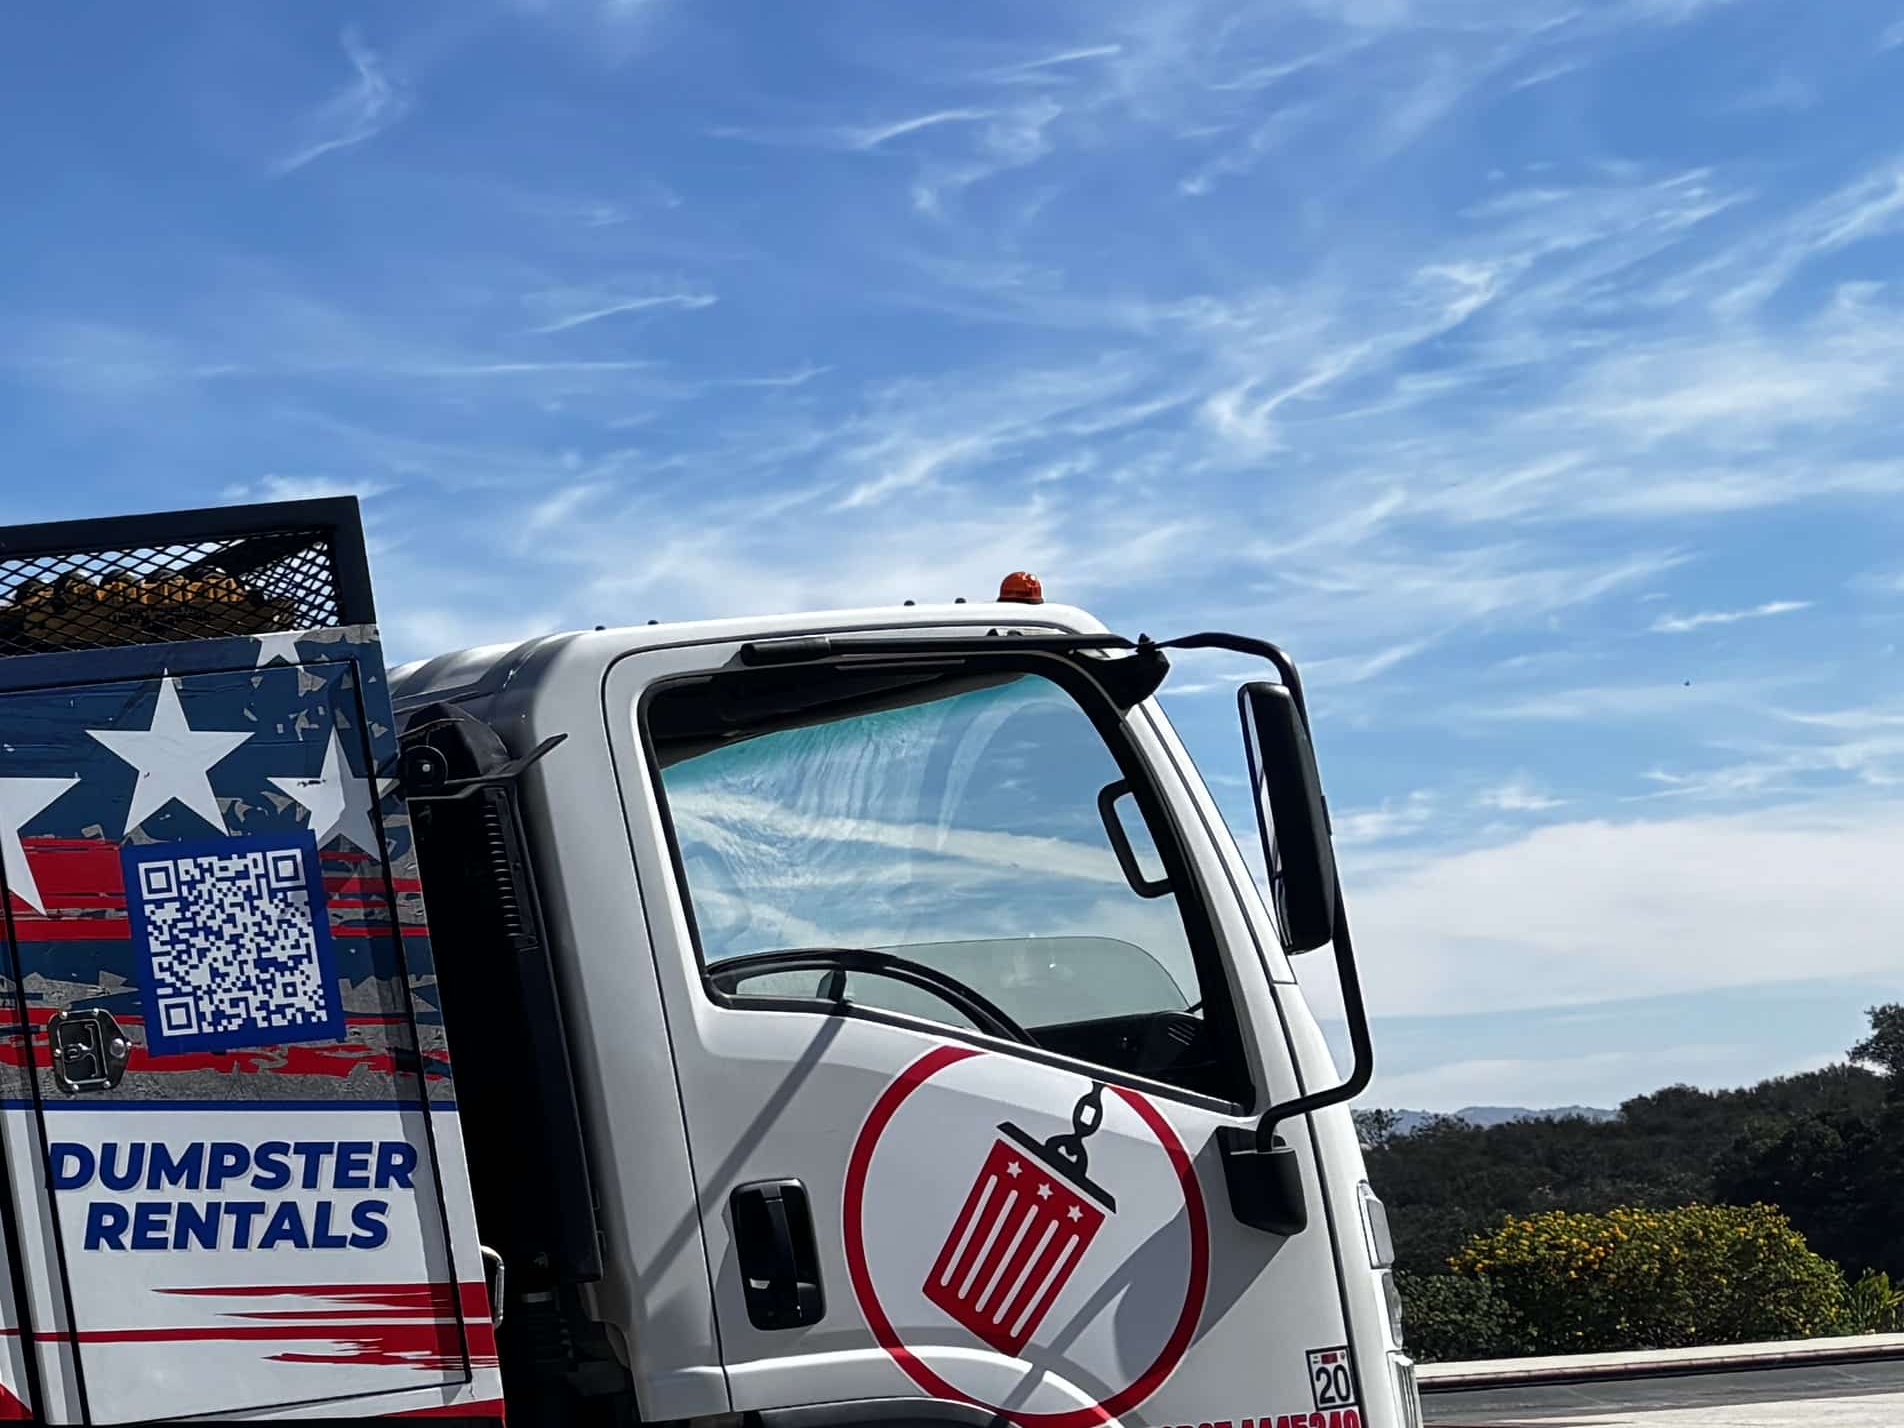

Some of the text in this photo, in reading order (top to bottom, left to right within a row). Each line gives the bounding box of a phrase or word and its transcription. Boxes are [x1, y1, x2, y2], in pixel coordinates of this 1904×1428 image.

[49, 1140, 419, 1191] DUMPSTER
[83, 1200, 391, 1252] RENTALS
[1315, 1363, 1352, 1405] 20
